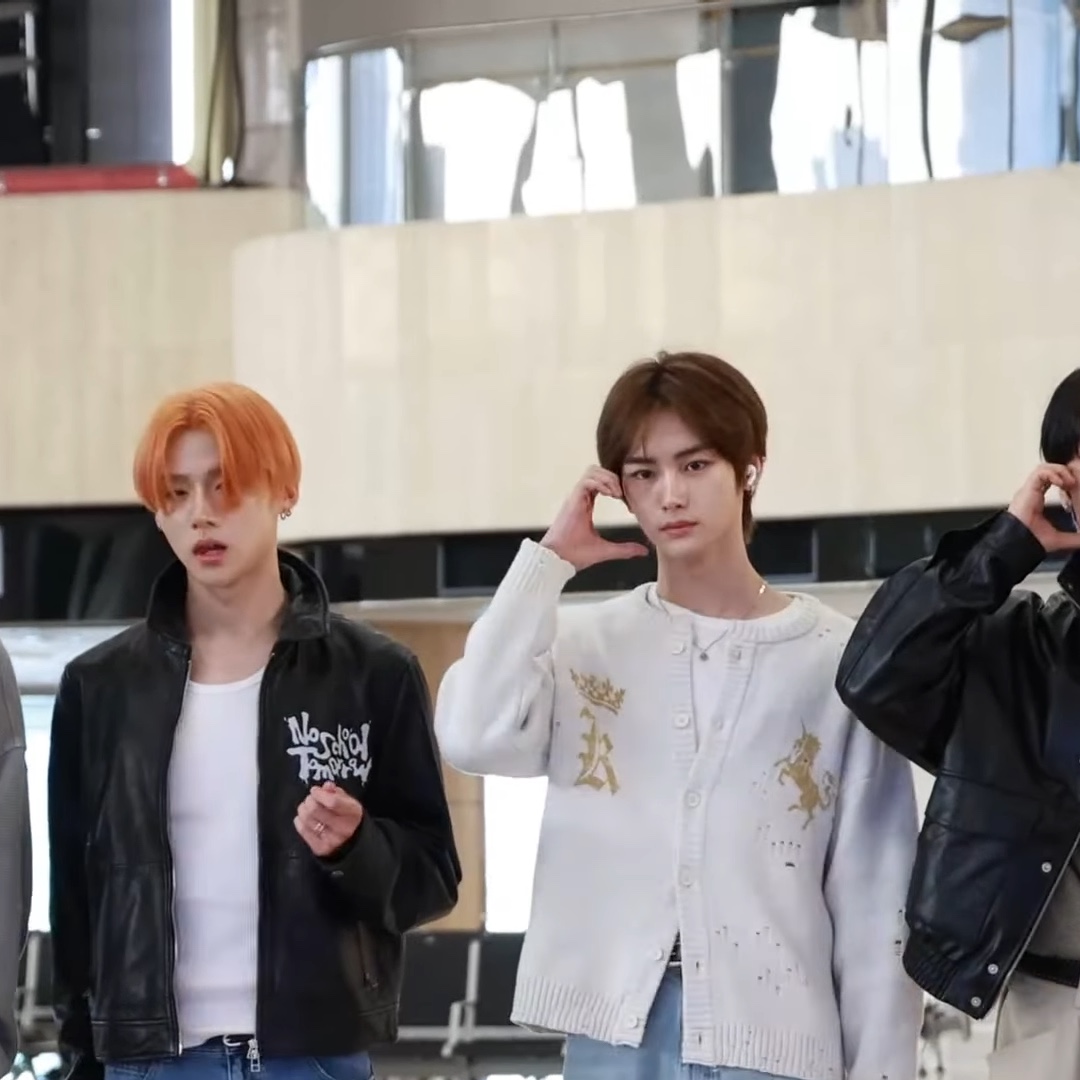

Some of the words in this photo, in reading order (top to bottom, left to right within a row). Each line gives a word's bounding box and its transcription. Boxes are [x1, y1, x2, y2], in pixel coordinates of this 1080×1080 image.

[287, 711, 320, 746] No
[315, 723, 371, 761] School
[286, 746, 373, 787] Tomorrow
